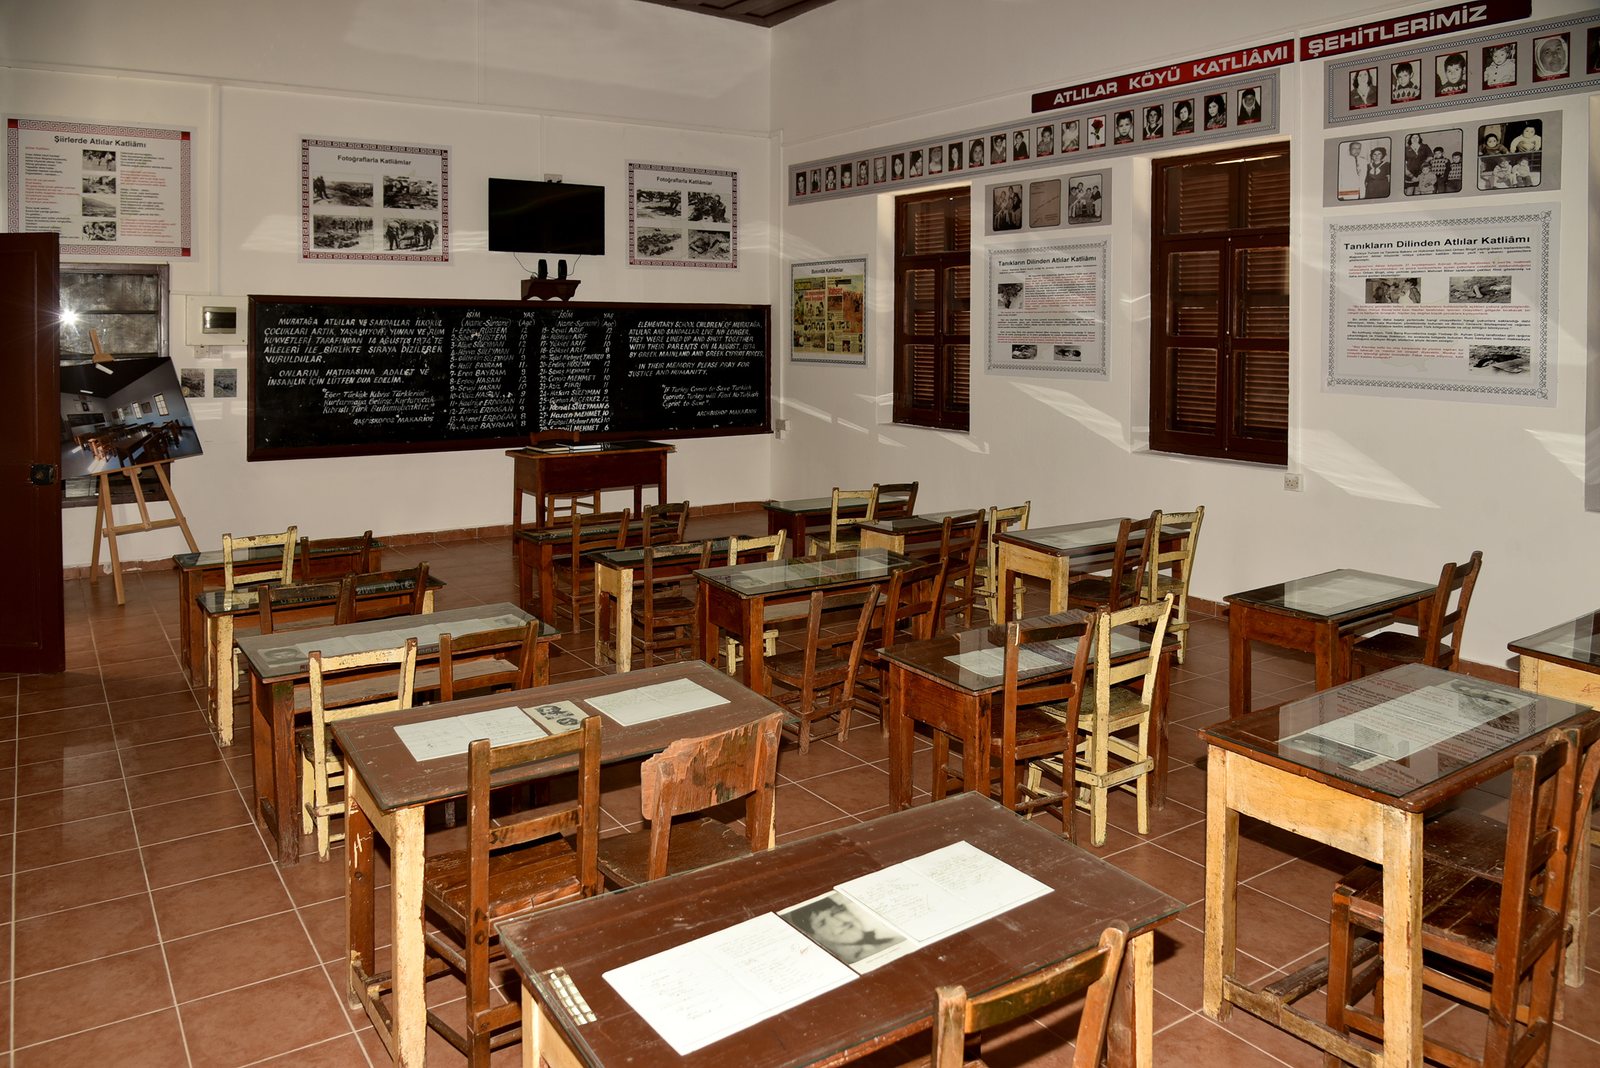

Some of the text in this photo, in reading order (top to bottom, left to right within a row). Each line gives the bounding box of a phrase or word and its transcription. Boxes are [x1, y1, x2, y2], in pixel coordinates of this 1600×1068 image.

[1308, 5, 1487, 57] ŞEHİTLERİMİZ
[1053, 45, 1288, 105] ATLILAR KÖYÜ KATLİÂMI
[54, 135, 88, 144] Şiirlerde
[90, 138, 113, 146] Atlılar
[1344, 235, 1531, 250] Tanıkların Dilinden Atlılar Katliâmı
[998, 259, 1026, 267] Tanıkların
[278, 316, 318, 326] MURATAĞA
[369, 319, 411, 327] SANDALLAR
[264, 327, 309, 336] ÇOCUKLARI
[279, 369, 320, 377] ONLARIN
[326, 369, 376, 377] HATIRASINA
